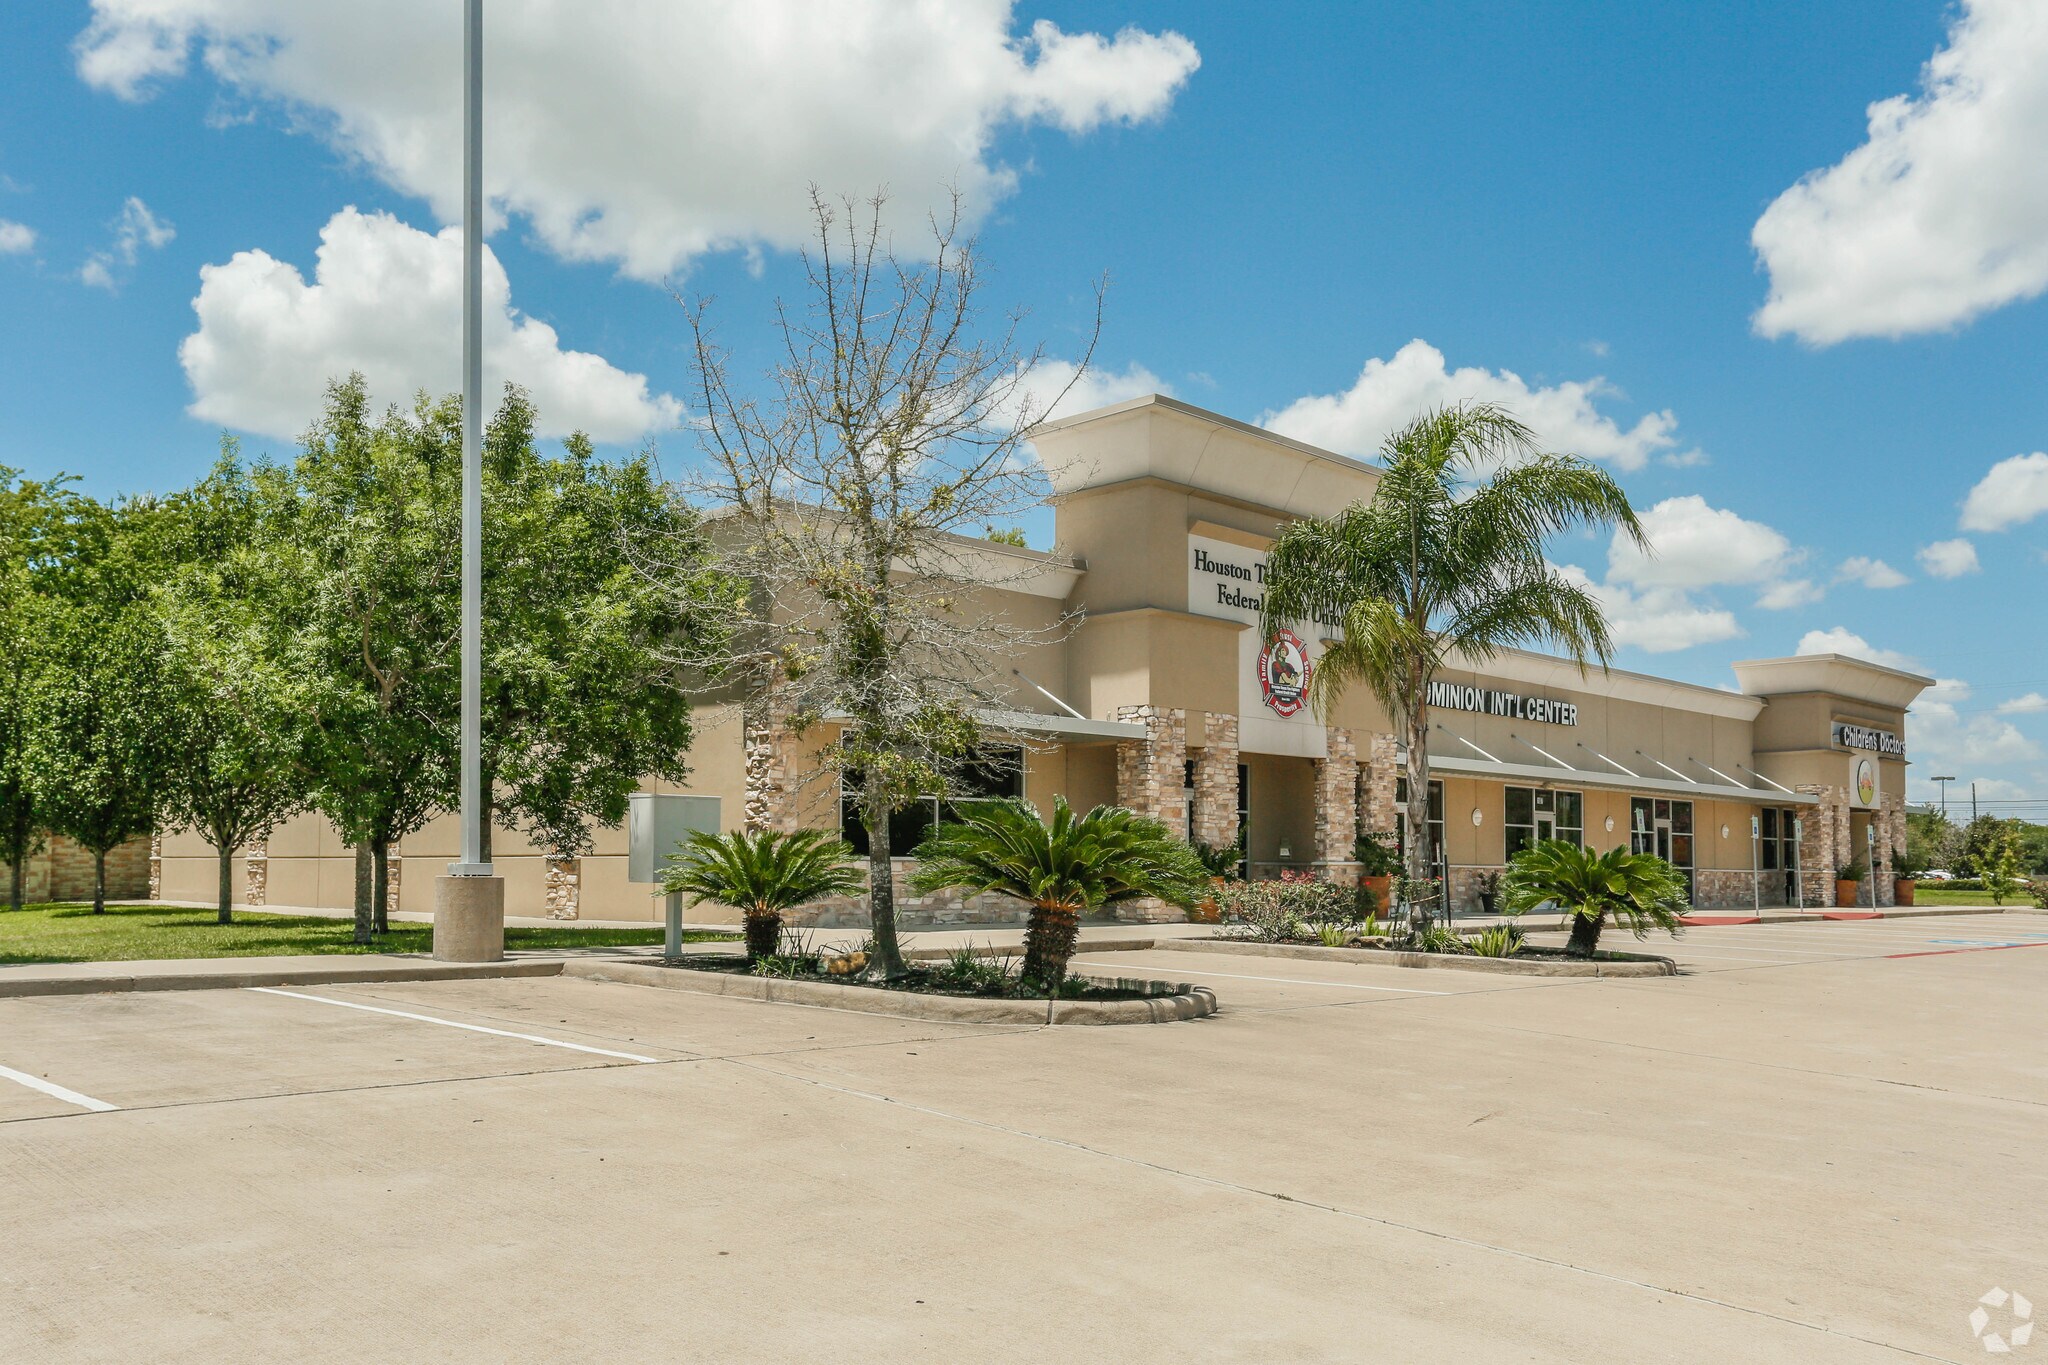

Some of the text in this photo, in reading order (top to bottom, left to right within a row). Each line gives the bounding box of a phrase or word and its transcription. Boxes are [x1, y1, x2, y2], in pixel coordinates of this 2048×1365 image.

[1194, 549, 1252, 582] Houston
[1217, 583, 1265, 611] Federal
[1490, 691, 1524, 719] INT'L
[1526, 697, 1578, 726] CENTER
[1844, 726, 1906, 755] Children's Doctors
